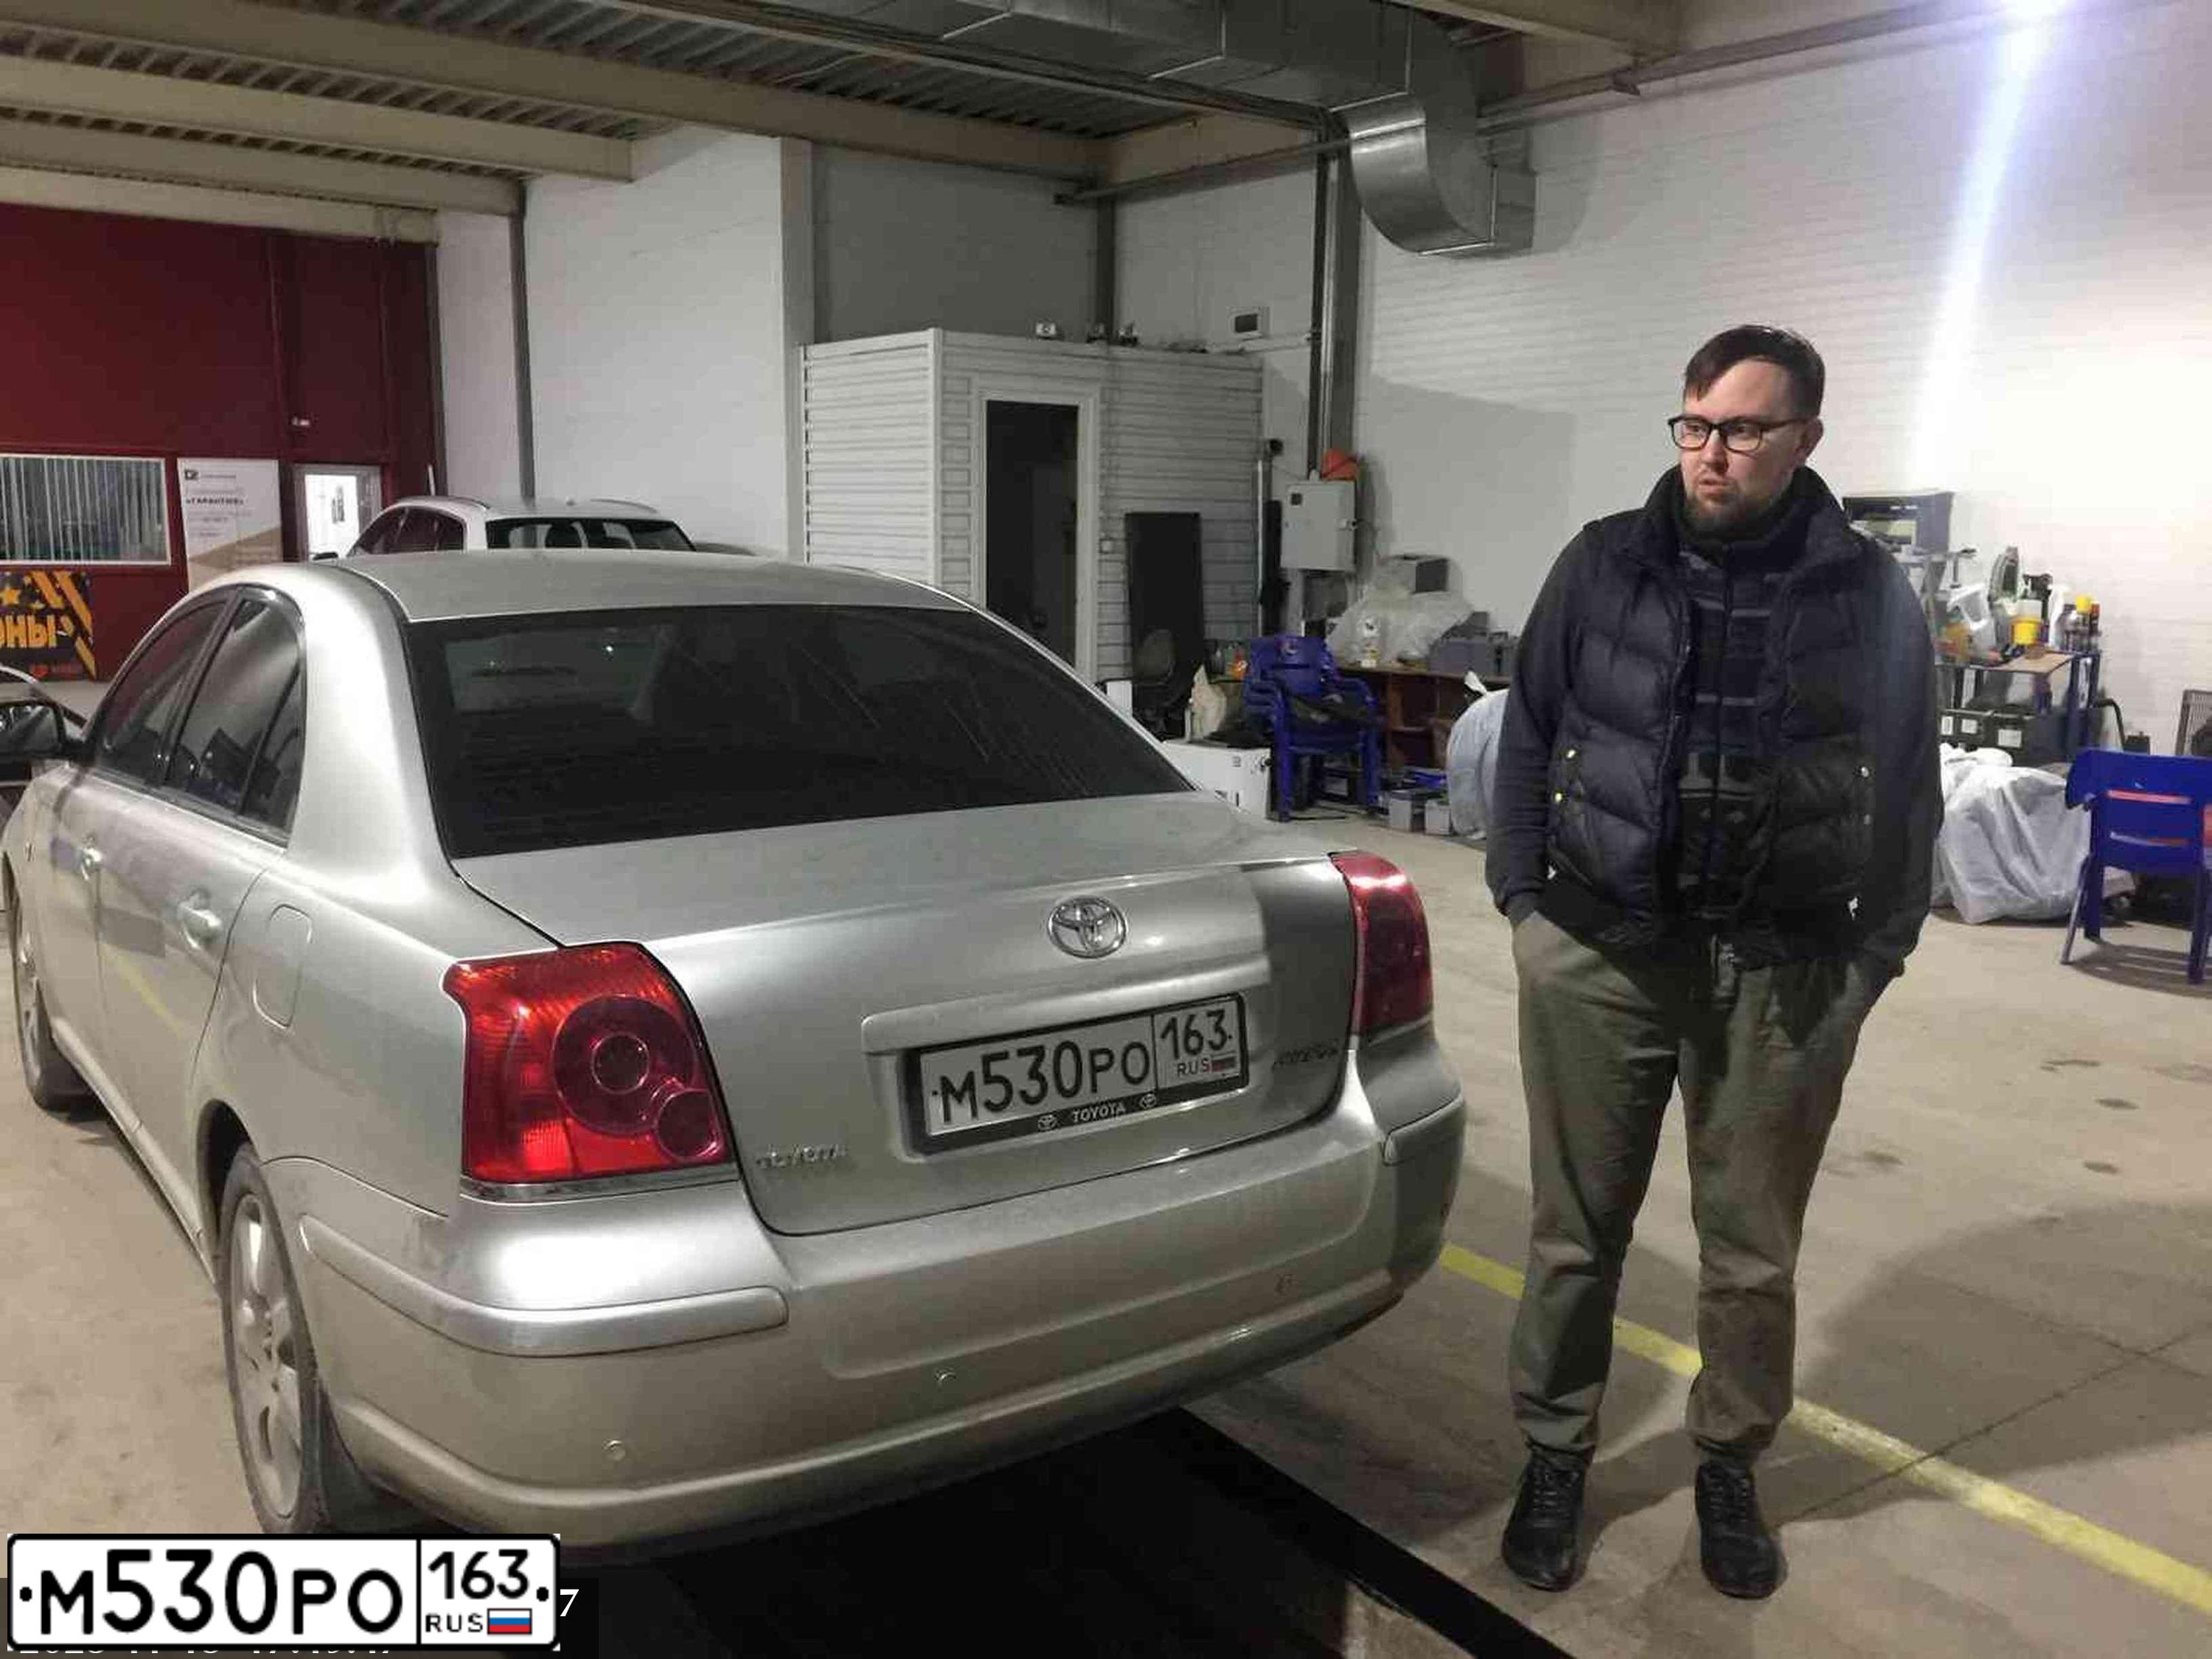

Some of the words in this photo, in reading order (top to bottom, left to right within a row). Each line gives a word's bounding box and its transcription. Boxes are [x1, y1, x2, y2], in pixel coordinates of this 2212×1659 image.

[0, 613, 57, 648] НЫ
[939, 1040, 1150, 1122] М530РО
[1160, 1009, 1228, 1060] 163
[1177, 1057, 1209, 1077] RUS
[1073, 1102, 1126, 1123] TOYOTA
